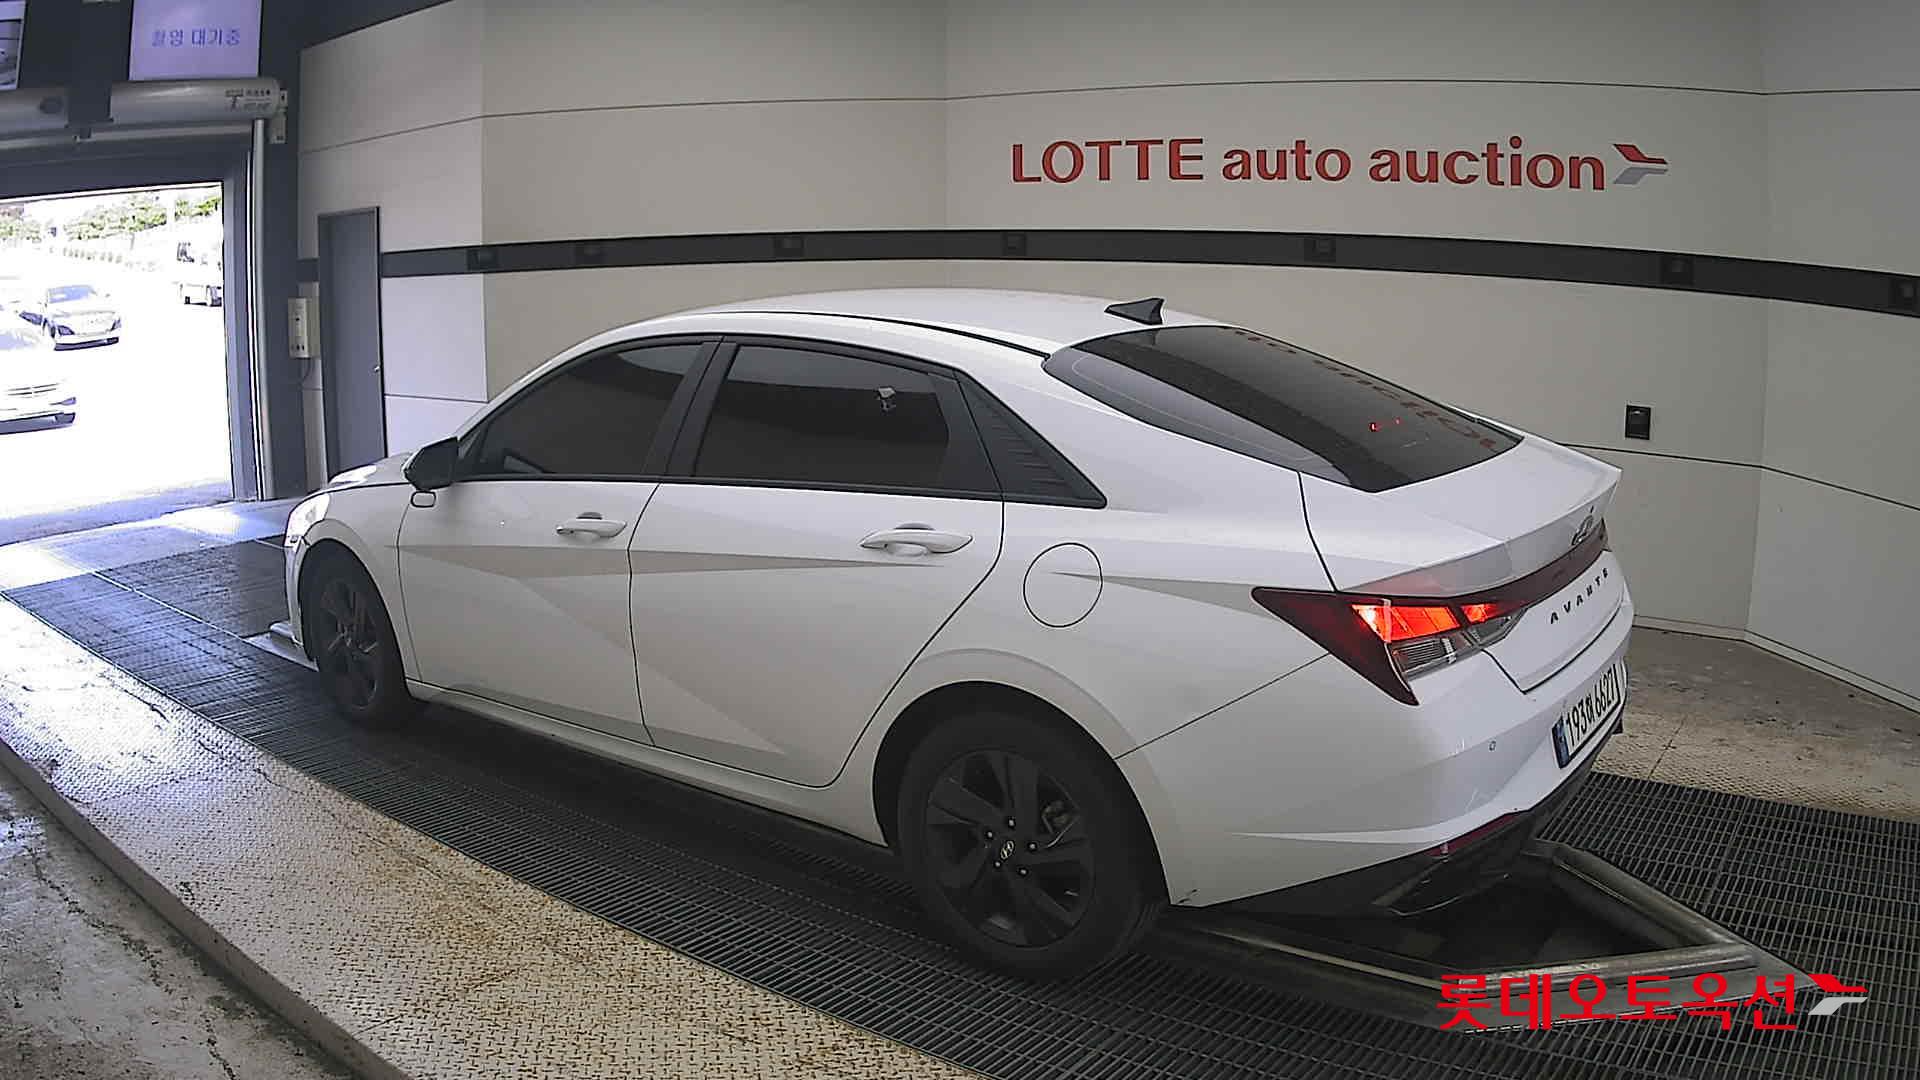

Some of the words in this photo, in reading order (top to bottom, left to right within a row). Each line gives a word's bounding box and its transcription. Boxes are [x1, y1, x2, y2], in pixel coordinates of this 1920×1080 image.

[1011, 138, 1204, 184] LOTTE
[1222, 139, 1352, 181] auto
[1368, 136, 1606, 191] auction
[1550, 568, 1609, 624] AVANTE
